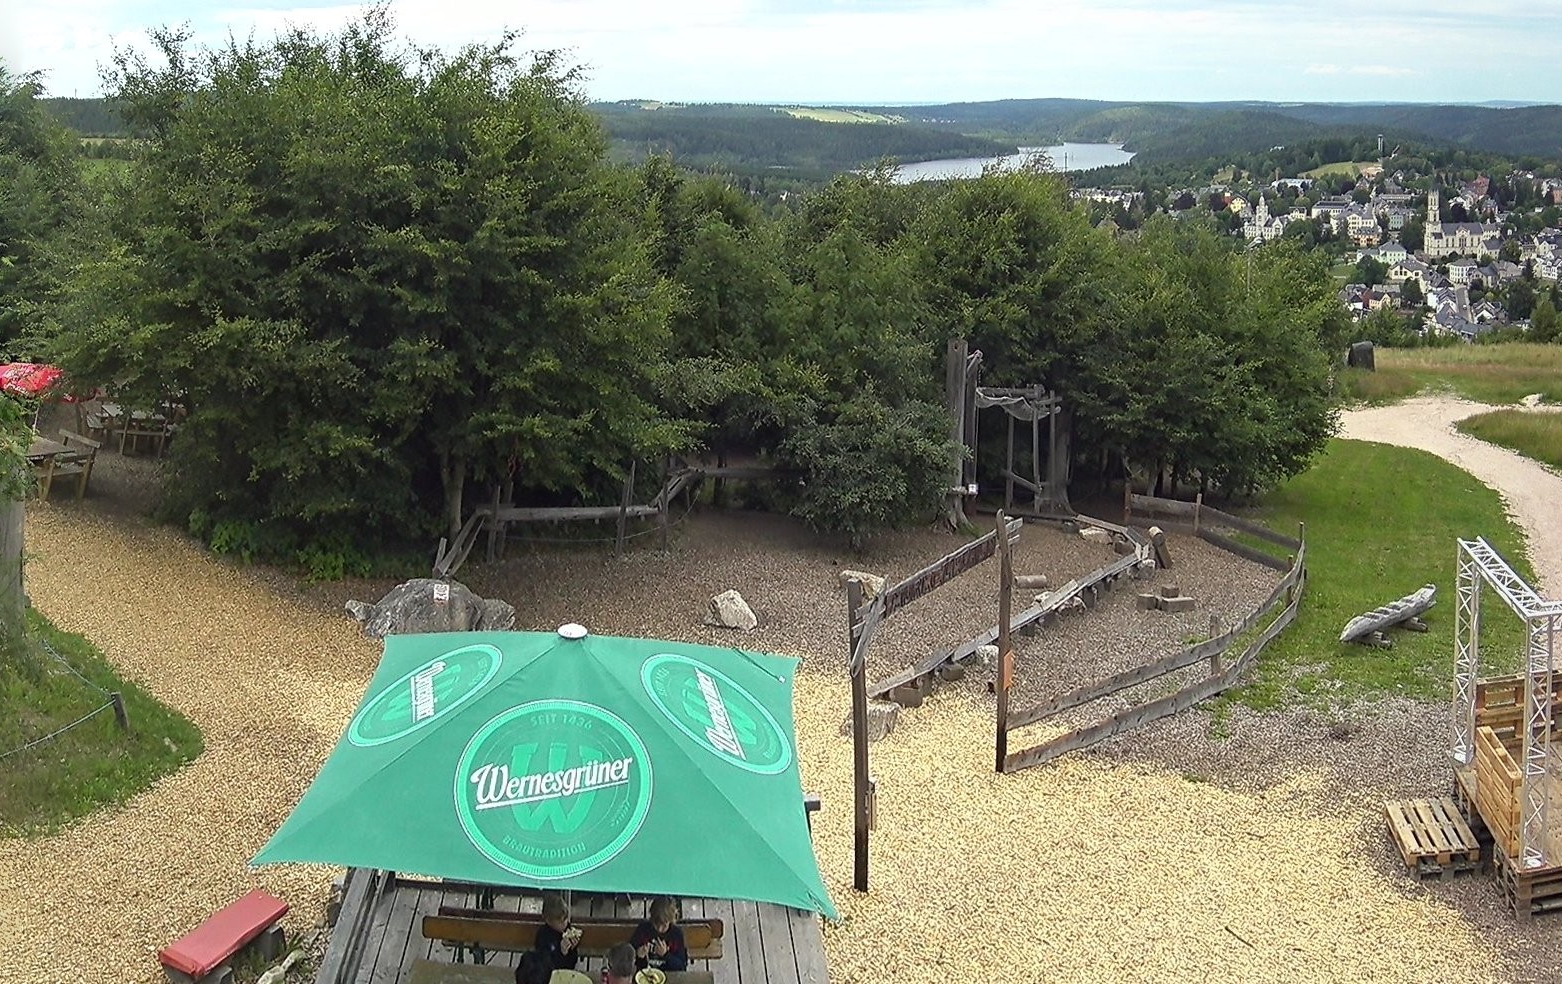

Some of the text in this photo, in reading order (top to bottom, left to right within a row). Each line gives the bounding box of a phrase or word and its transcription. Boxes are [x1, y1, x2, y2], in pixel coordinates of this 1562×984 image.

[530, 713, 558, 729] SEIT
[470, 756, 634, 805] Wernesgrüner
[502, 835, 587, 859] BRAUTRADITION
